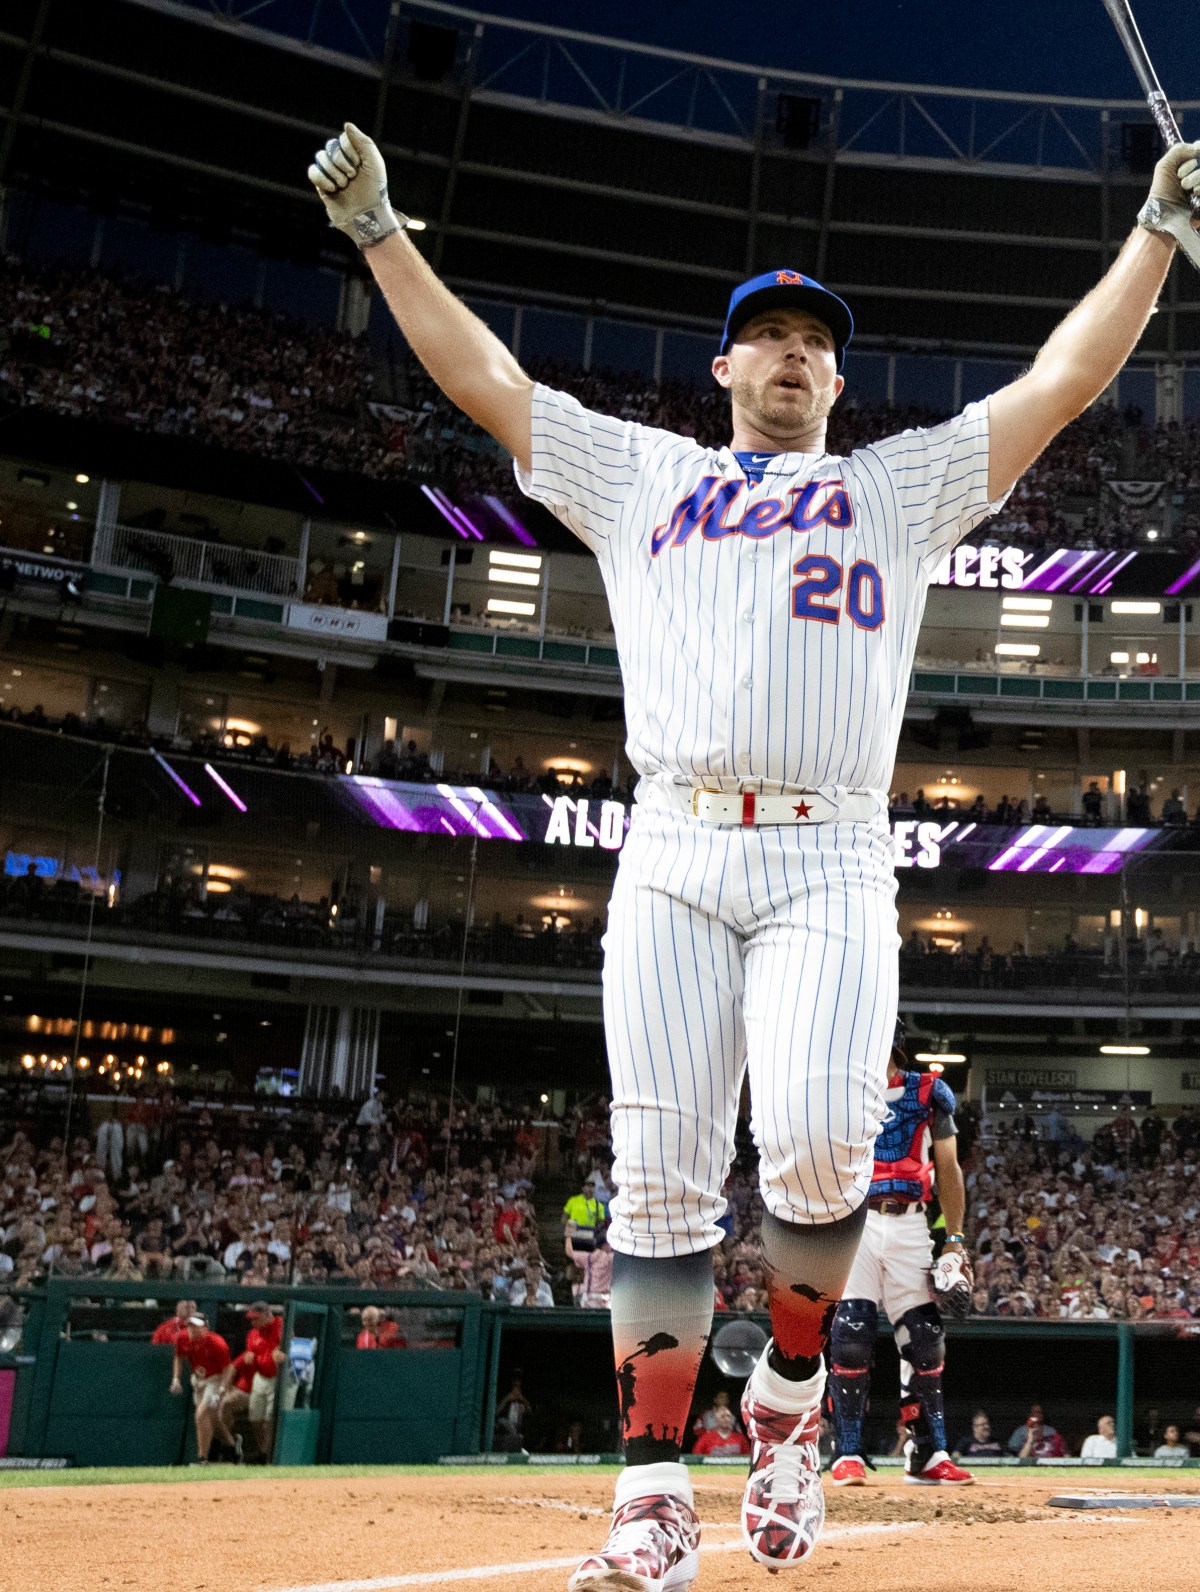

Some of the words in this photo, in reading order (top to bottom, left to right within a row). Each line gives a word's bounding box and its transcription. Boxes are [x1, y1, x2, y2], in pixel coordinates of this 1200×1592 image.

[651, 475, 853, 558] Mets
[792, 554, 886, 632] 20
[545, 796, 640, 850] ALO
